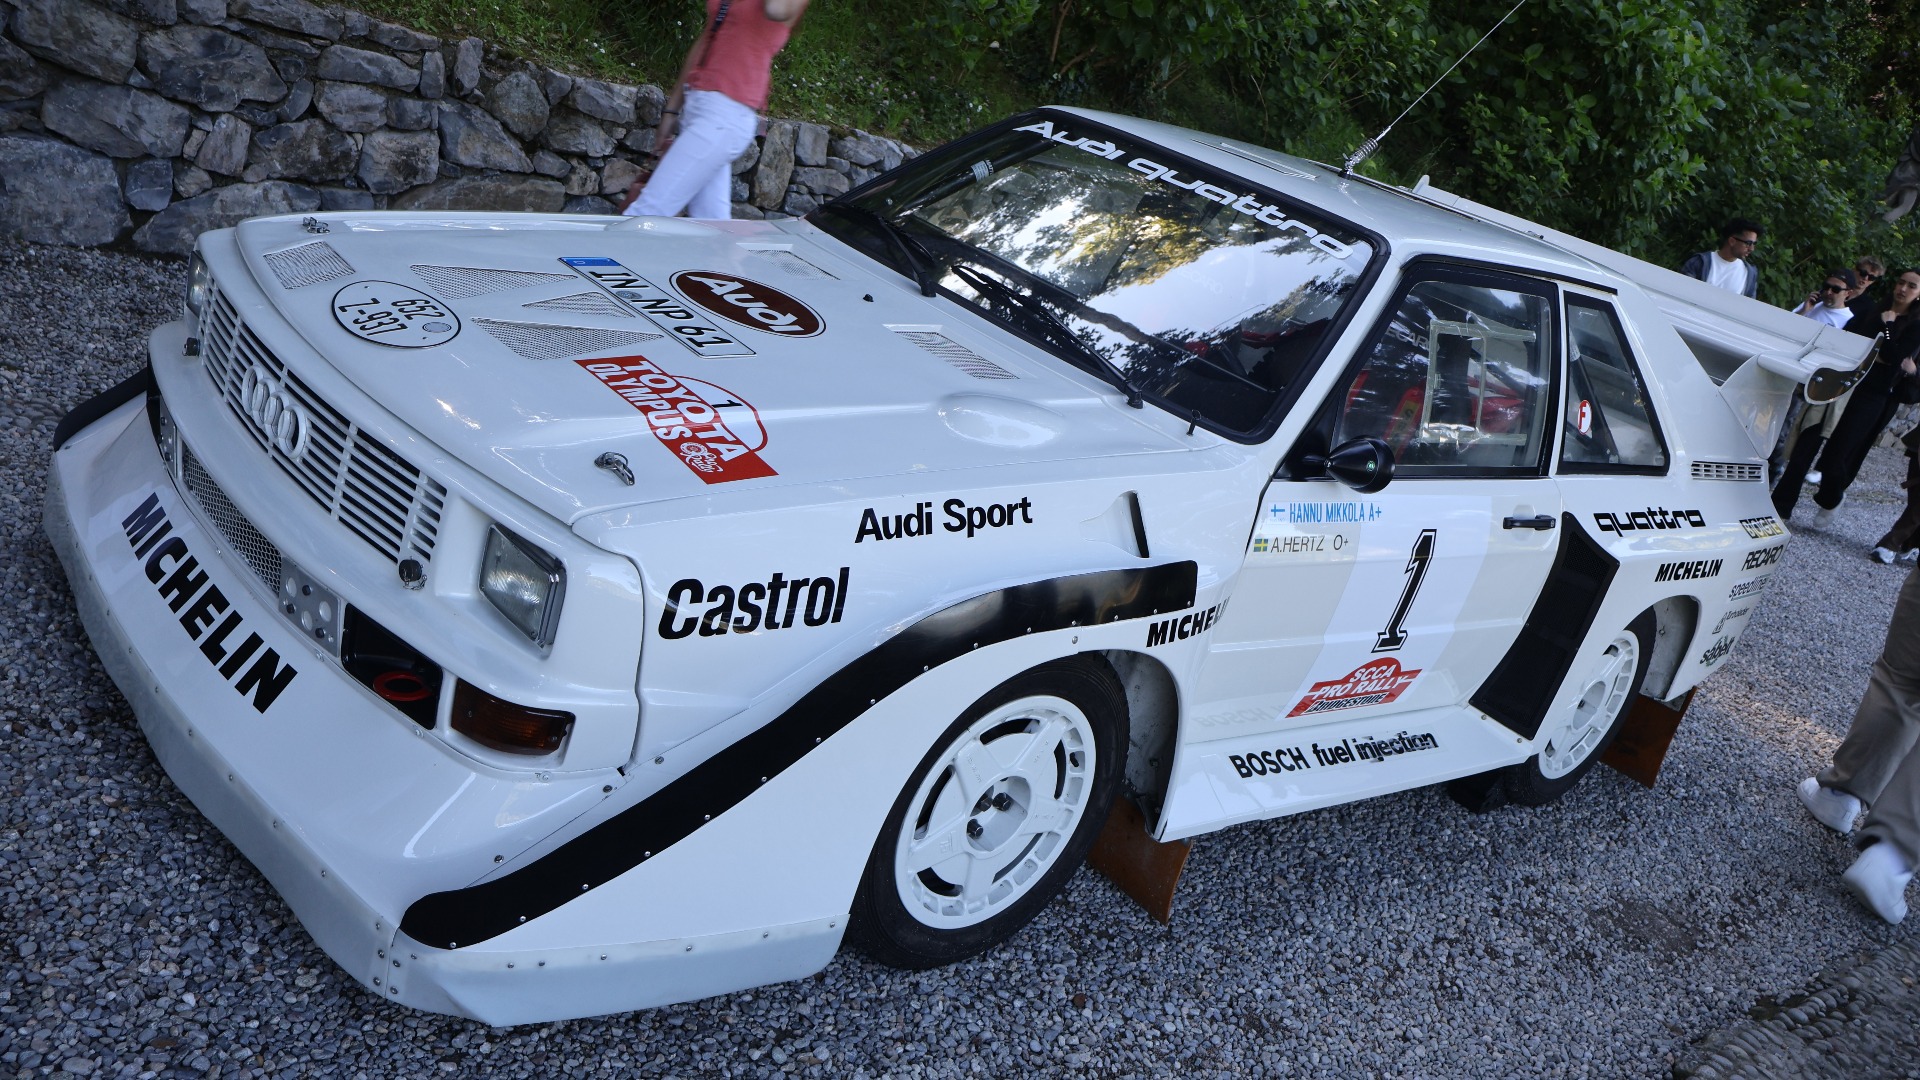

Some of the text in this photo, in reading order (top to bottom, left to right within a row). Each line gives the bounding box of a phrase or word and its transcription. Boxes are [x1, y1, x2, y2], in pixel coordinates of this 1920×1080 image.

[1013, 120, 1354, 260] Audi quattro
[390, 298, 446, 321] 652
[588, 270, 651, 289] IN
[631, 298, 695, 320] NP
[673, 326, 734, 348] 61
[685, 273, 805, 332] Audi
[585, 362, 693, 441] OLYMPUS
[622, 360, 751, 462] TOYOTA
[711, 399, 744, 409] 1
[855, 496, 1034, 543] Audi Sport
[1289, 502, 1383, 523] HANNU MIKKOLA A+
[1593, 506, 1707, 538] quattro
[1739, 516, 1784, 539] BOGE
[1270, 534, 1326, 554] A.HERTZ
[1741, 544, 1785, 572] RECARO
[1654, 558, 1724, 583] MICHELIN
[121, 492, 298, 714] MICHELIN
[657, 567, 851, 641] Castrol
[1371, 529, 1438, 653] 1
[1311, 675, 1408, 701] PRO RALLY
[1350, 664, 1396, 683] SCCA
[1304, 691, 1388, 714] BRIDGESTONE
[1228, 730, 1440, 779] BOSCH fuel injection
